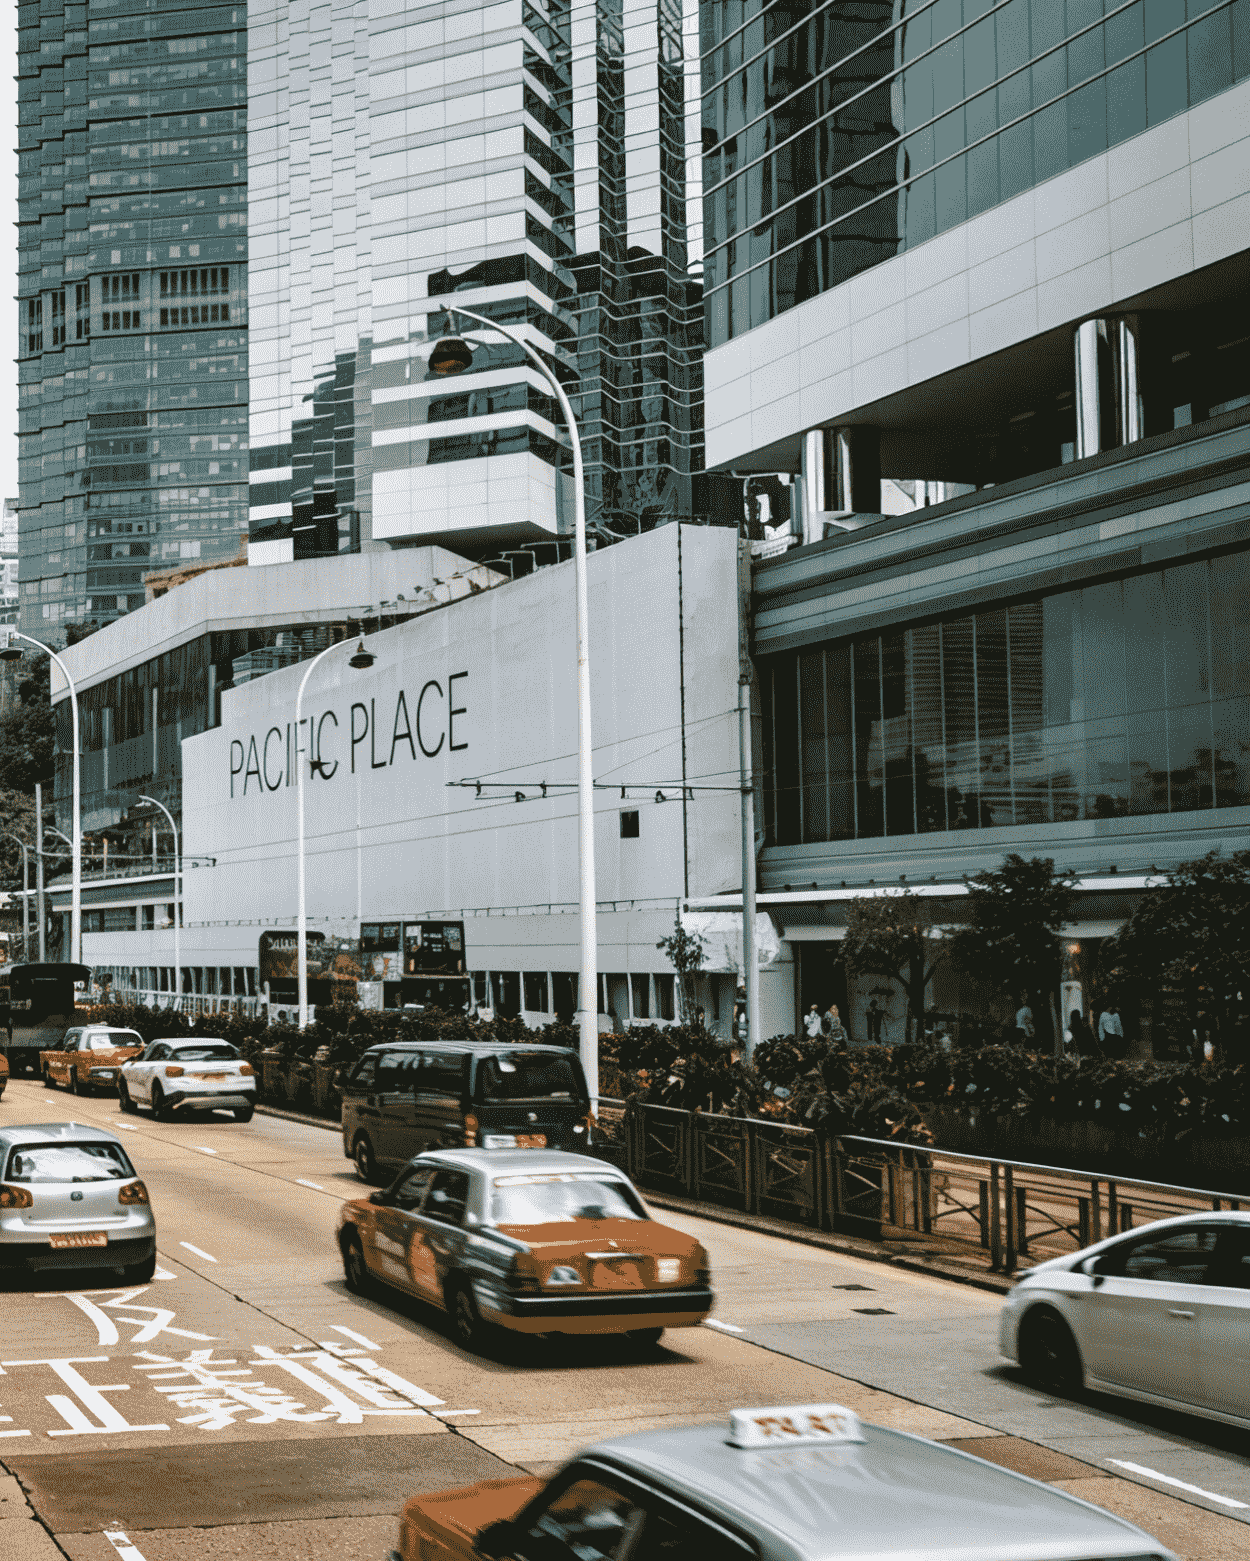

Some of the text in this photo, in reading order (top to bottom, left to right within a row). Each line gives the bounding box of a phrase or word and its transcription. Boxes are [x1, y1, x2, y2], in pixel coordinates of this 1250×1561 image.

[230, 670, 469, 799] PACIFIC PLACE
[0, 1344, 481, 1436] 正義道
